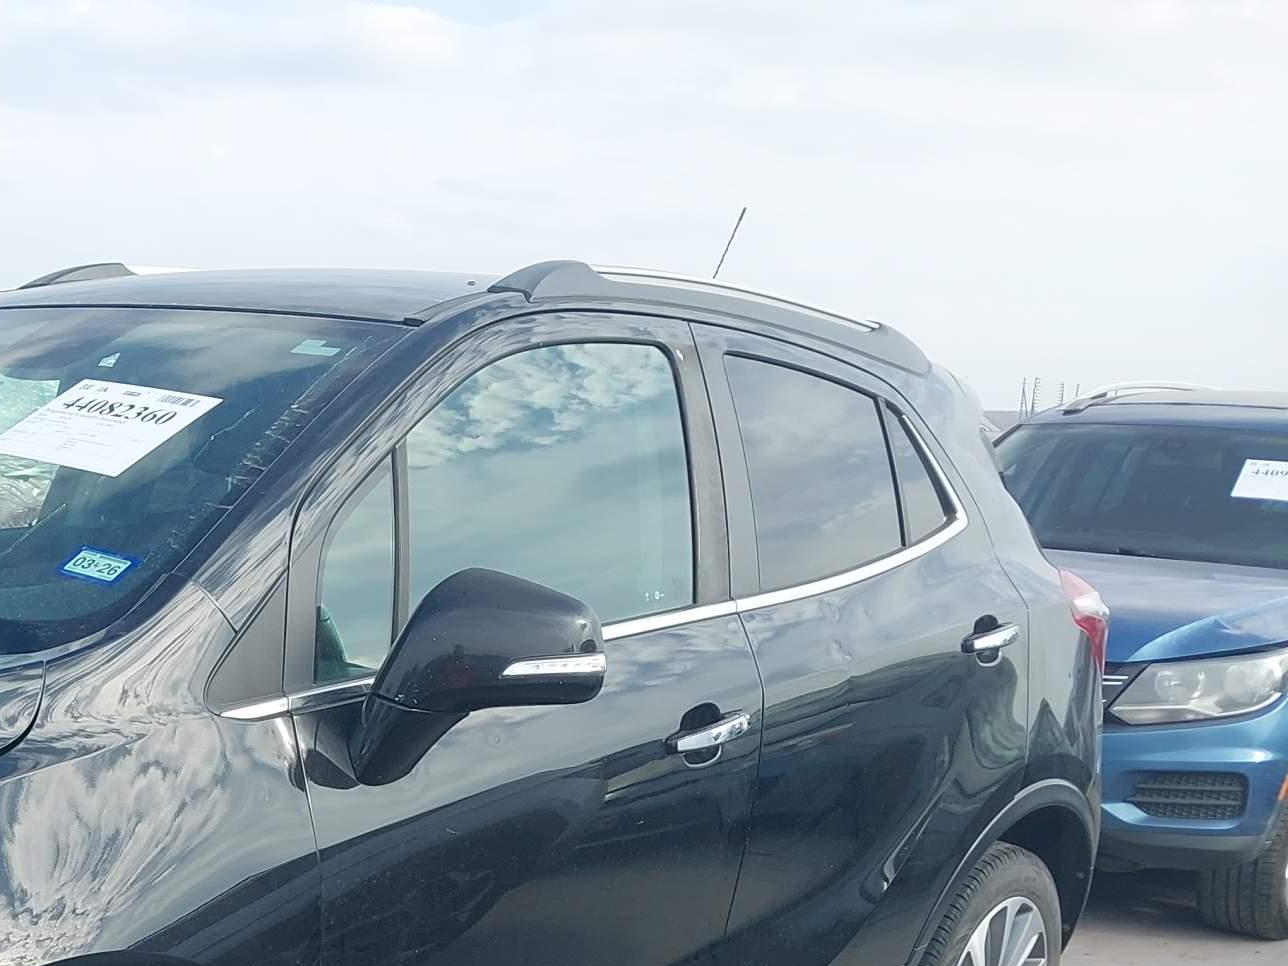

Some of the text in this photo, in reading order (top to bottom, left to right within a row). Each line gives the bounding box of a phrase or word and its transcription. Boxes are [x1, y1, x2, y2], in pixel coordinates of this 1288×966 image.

[62, 396, 177, 425] 44082360
[72, 556, 95, 570] 03
[96, 563, 121, 576] 26
